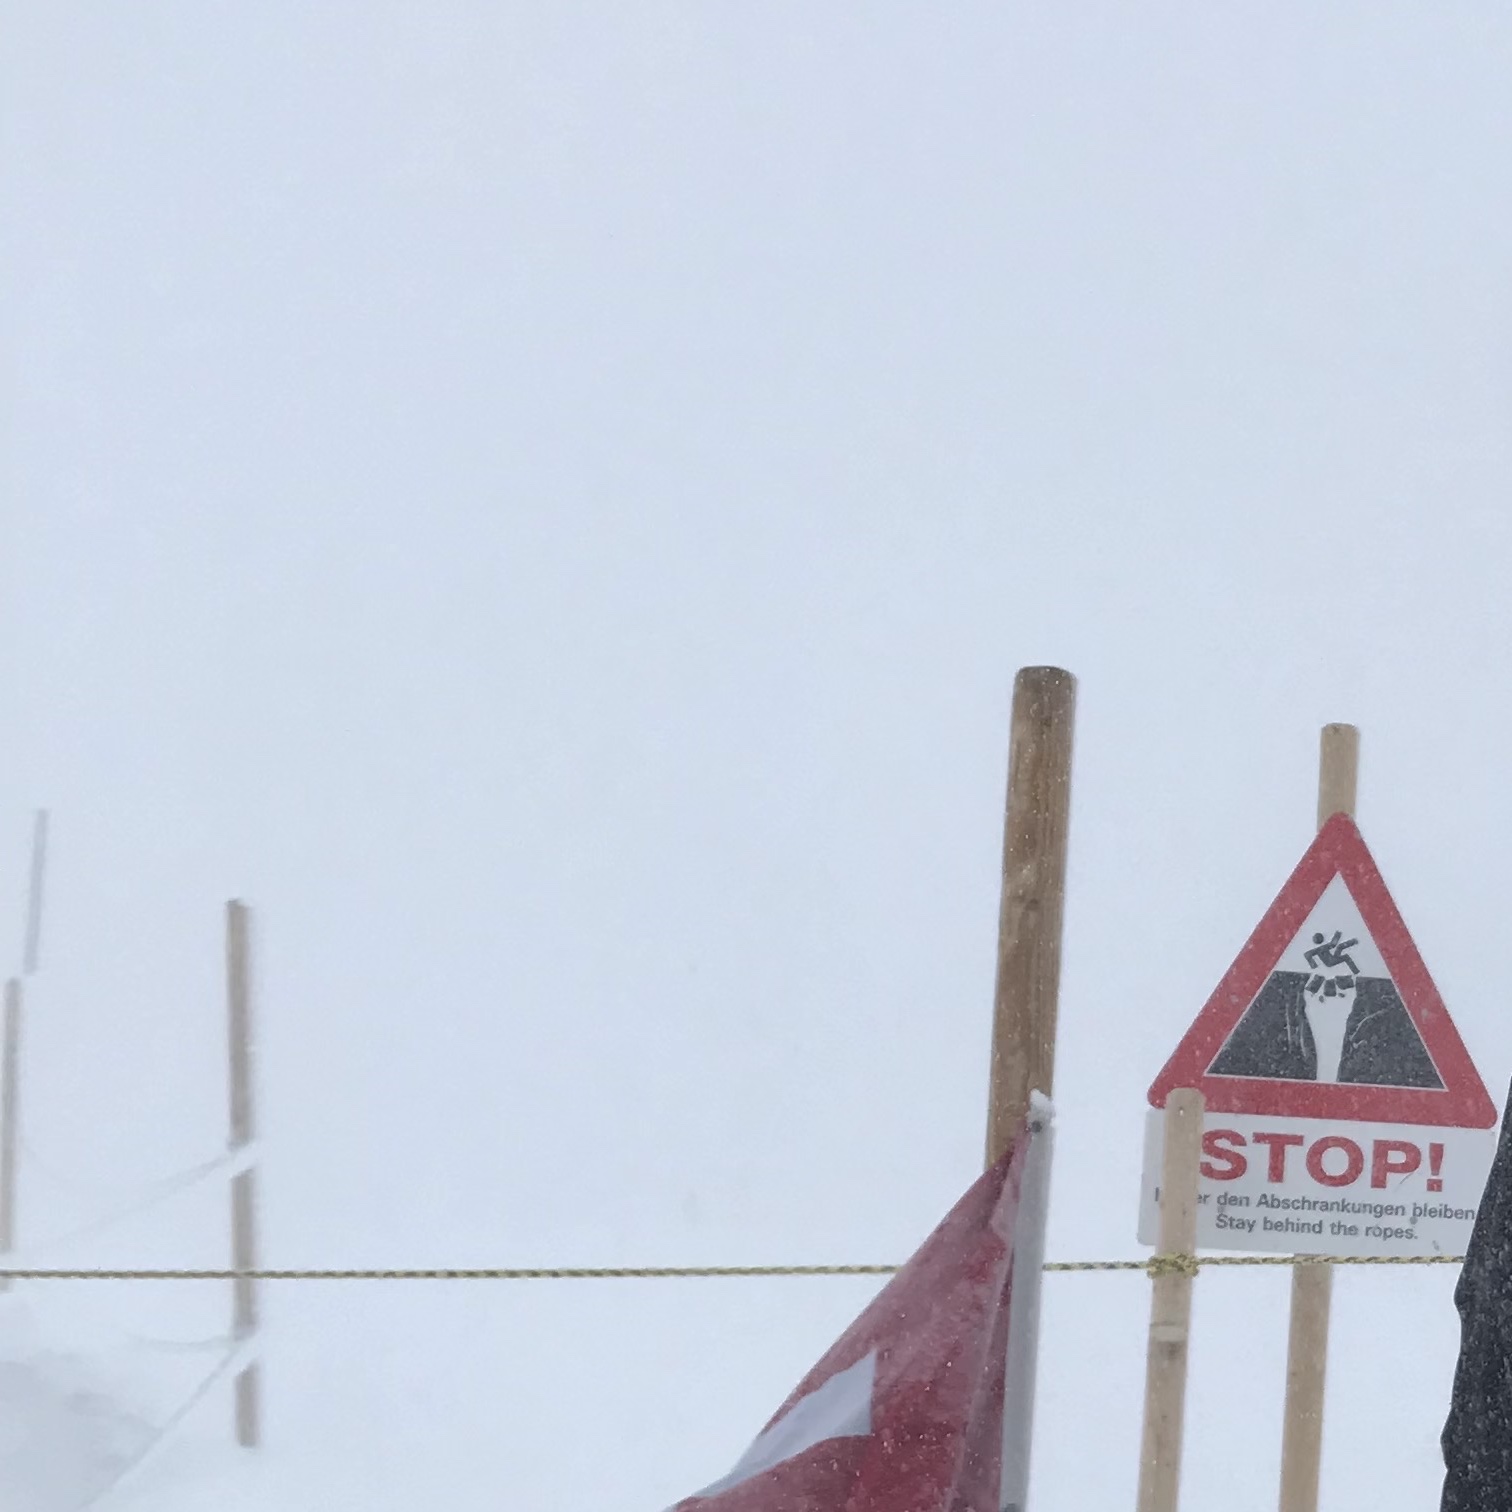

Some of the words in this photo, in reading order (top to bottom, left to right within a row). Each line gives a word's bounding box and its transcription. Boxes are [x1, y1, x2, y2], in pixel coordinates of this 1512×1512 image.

[1199, 1129, 1446, 1193] STOP!
[1216, 1191, 1250, 1207] den
[1255, 1193, 1406, 1219] Abschrankungen
[1412, 1201, 1476, 1220] bleiben
[1215, 1213, 1256, 1234] Stay
[1262, 1216, 1323, 1235] behind
[1330, 1219, 1359, 1236] the
[1364, 1224, 1419, 1241] ropes.
